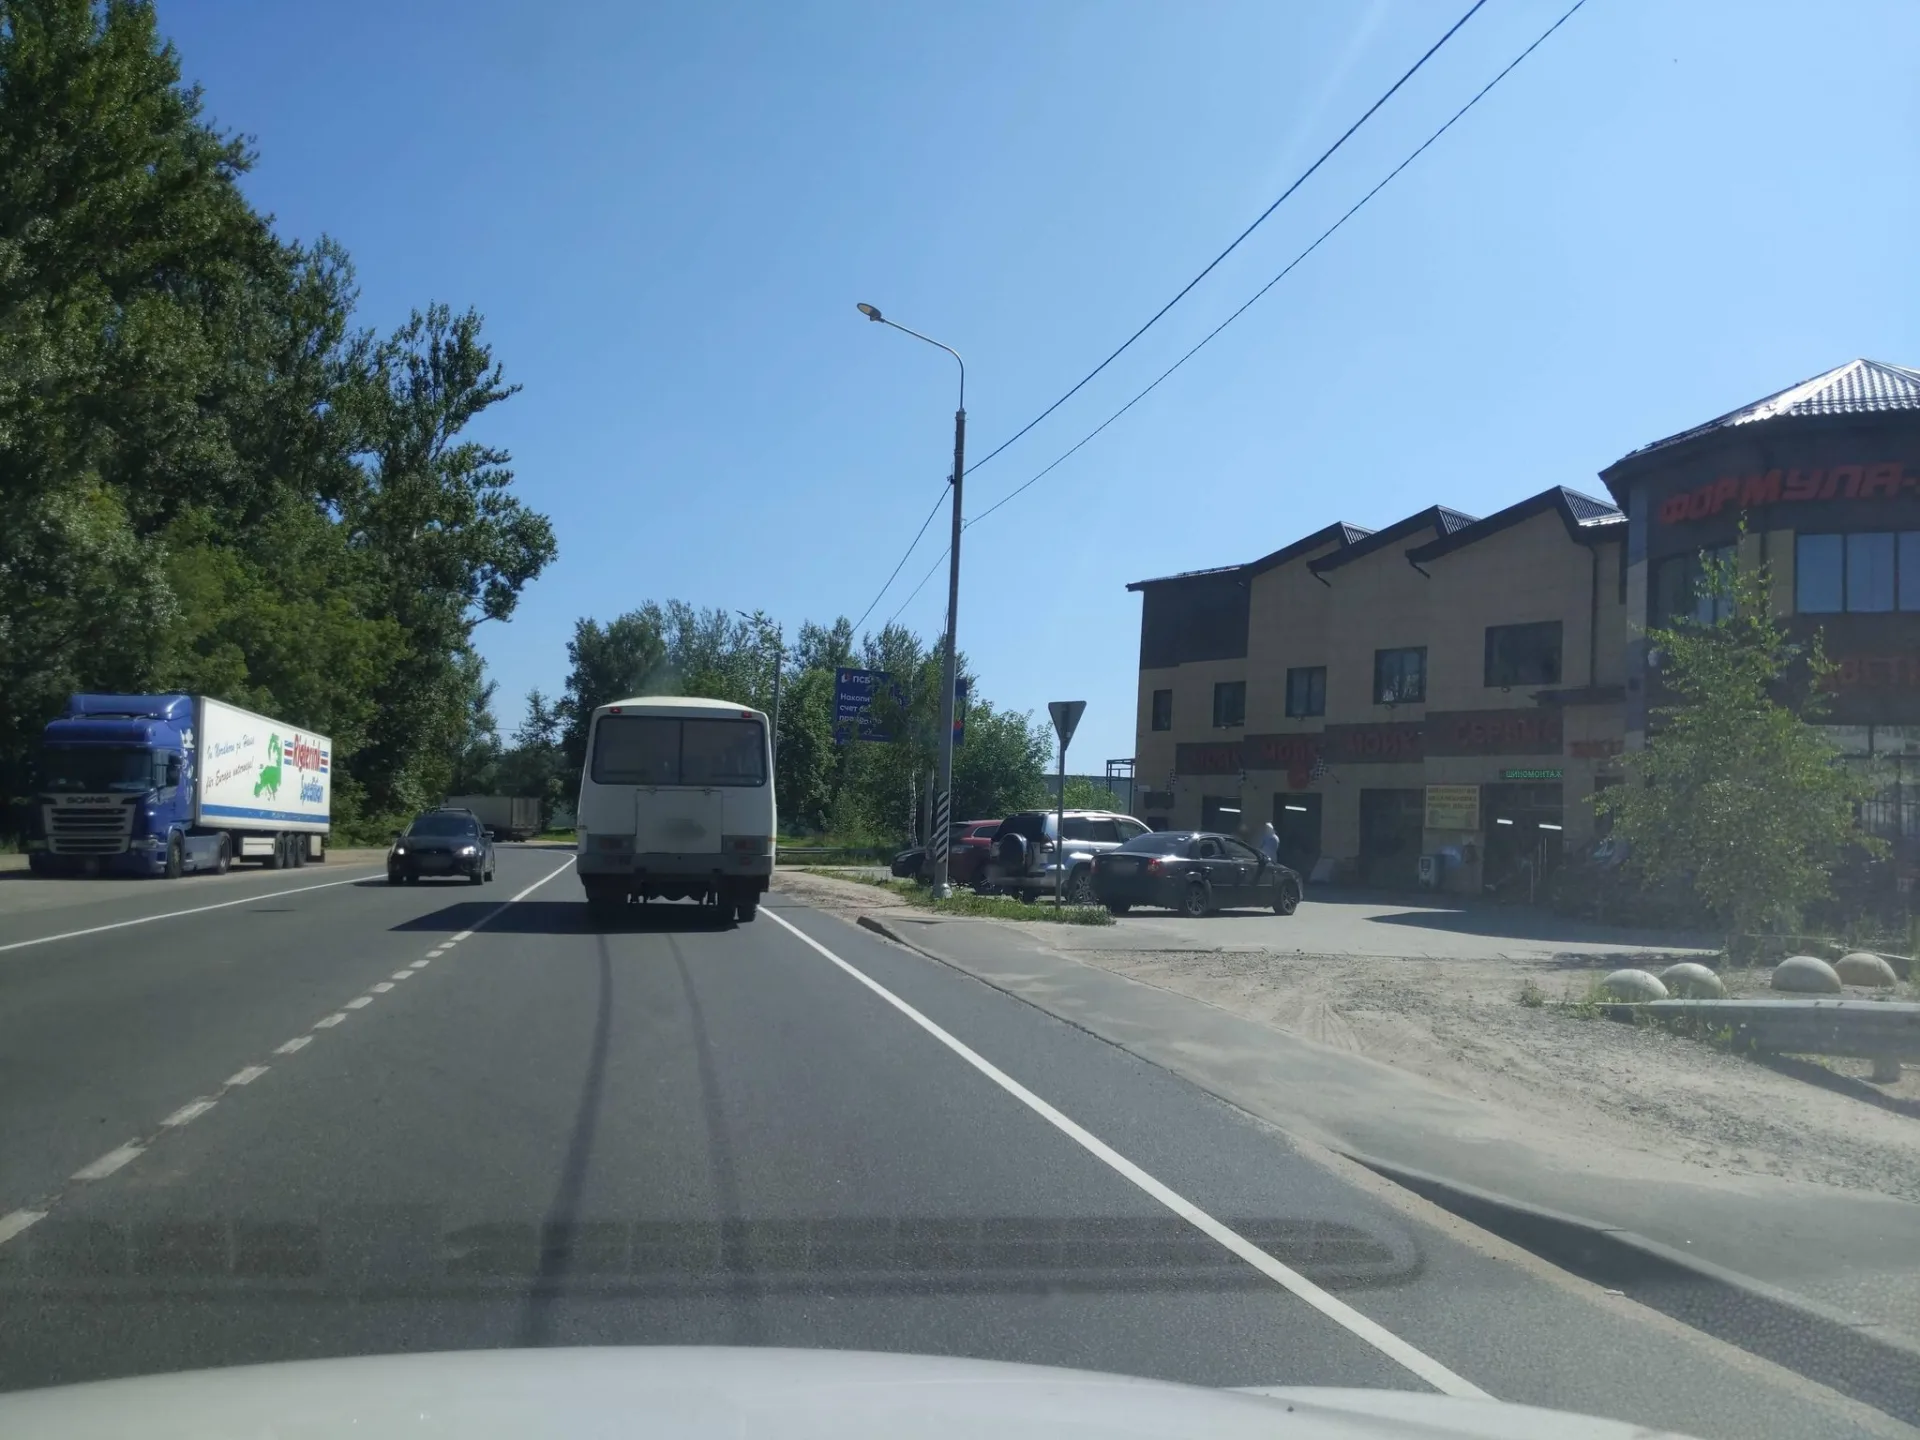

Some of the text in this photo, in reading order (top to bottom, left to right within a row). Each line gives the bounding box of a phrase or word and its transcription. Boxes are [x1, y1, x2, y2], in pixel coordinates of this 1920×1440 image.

[1659, 461, 1919, 524] ФОРМУЛА-
[1506, 768, 1562, 779] ШИНОМОНТАЖ
[66, 795, 111, 804] SCANIA
